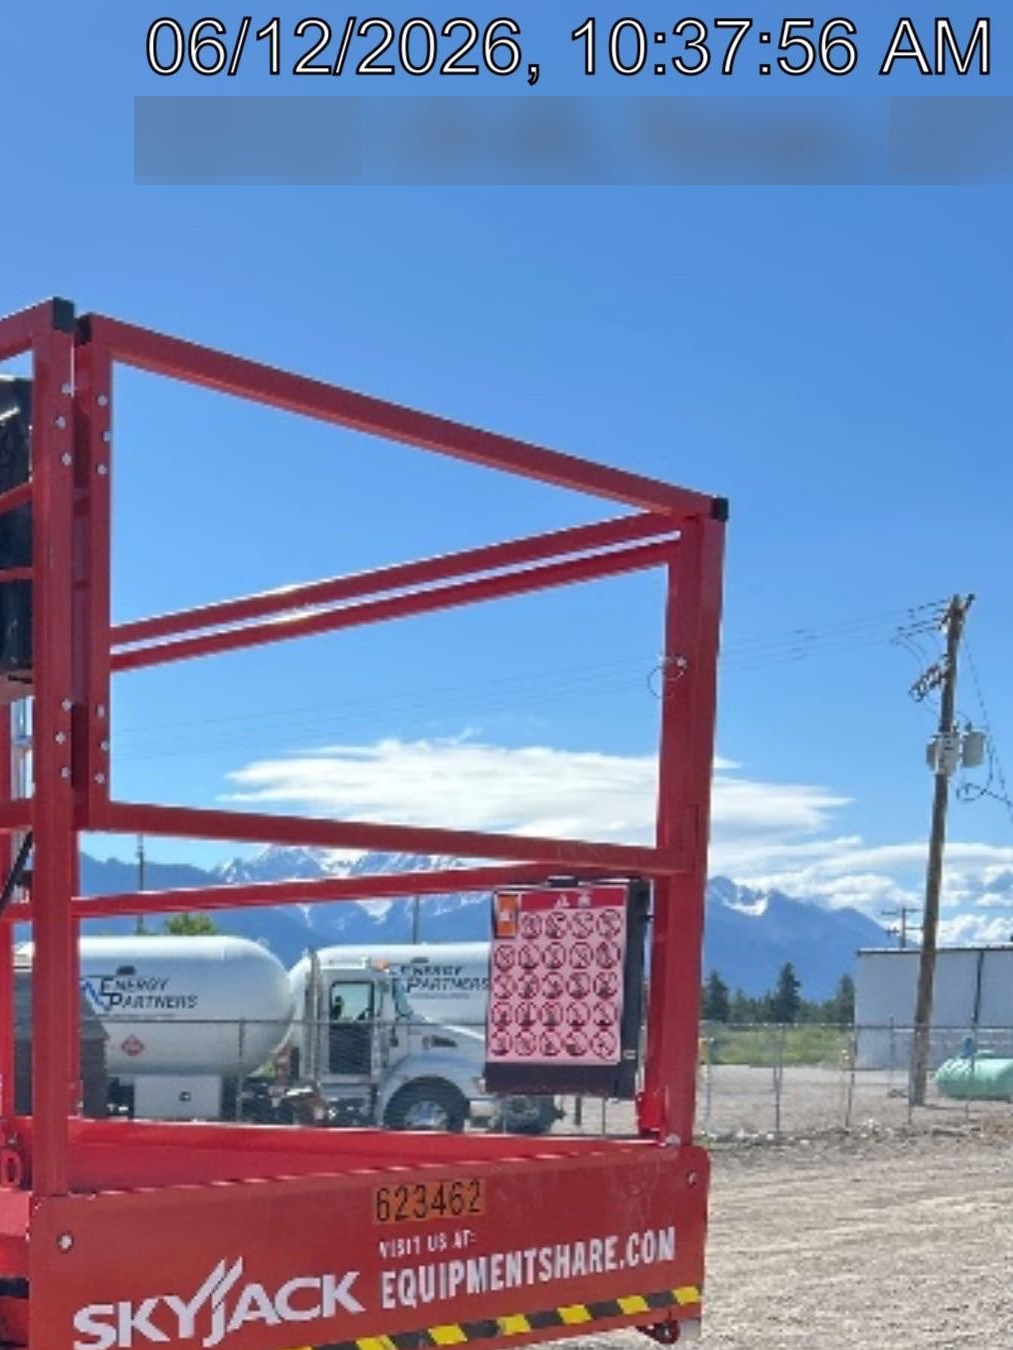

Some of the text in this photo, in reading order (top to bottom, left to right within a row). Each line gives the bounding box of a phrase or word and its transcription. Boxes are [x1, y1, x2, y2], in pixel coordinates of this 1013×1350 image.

[108, 992, 198, 1009] PARTNERS
[375, 1180, 482, 1223] 623462
[379, 1238, 421, 1260] VISIT
[427, 1232, 448, 1252] US
[380, 1226, 678, 1309] EQUIPMENTSHARE.COM
